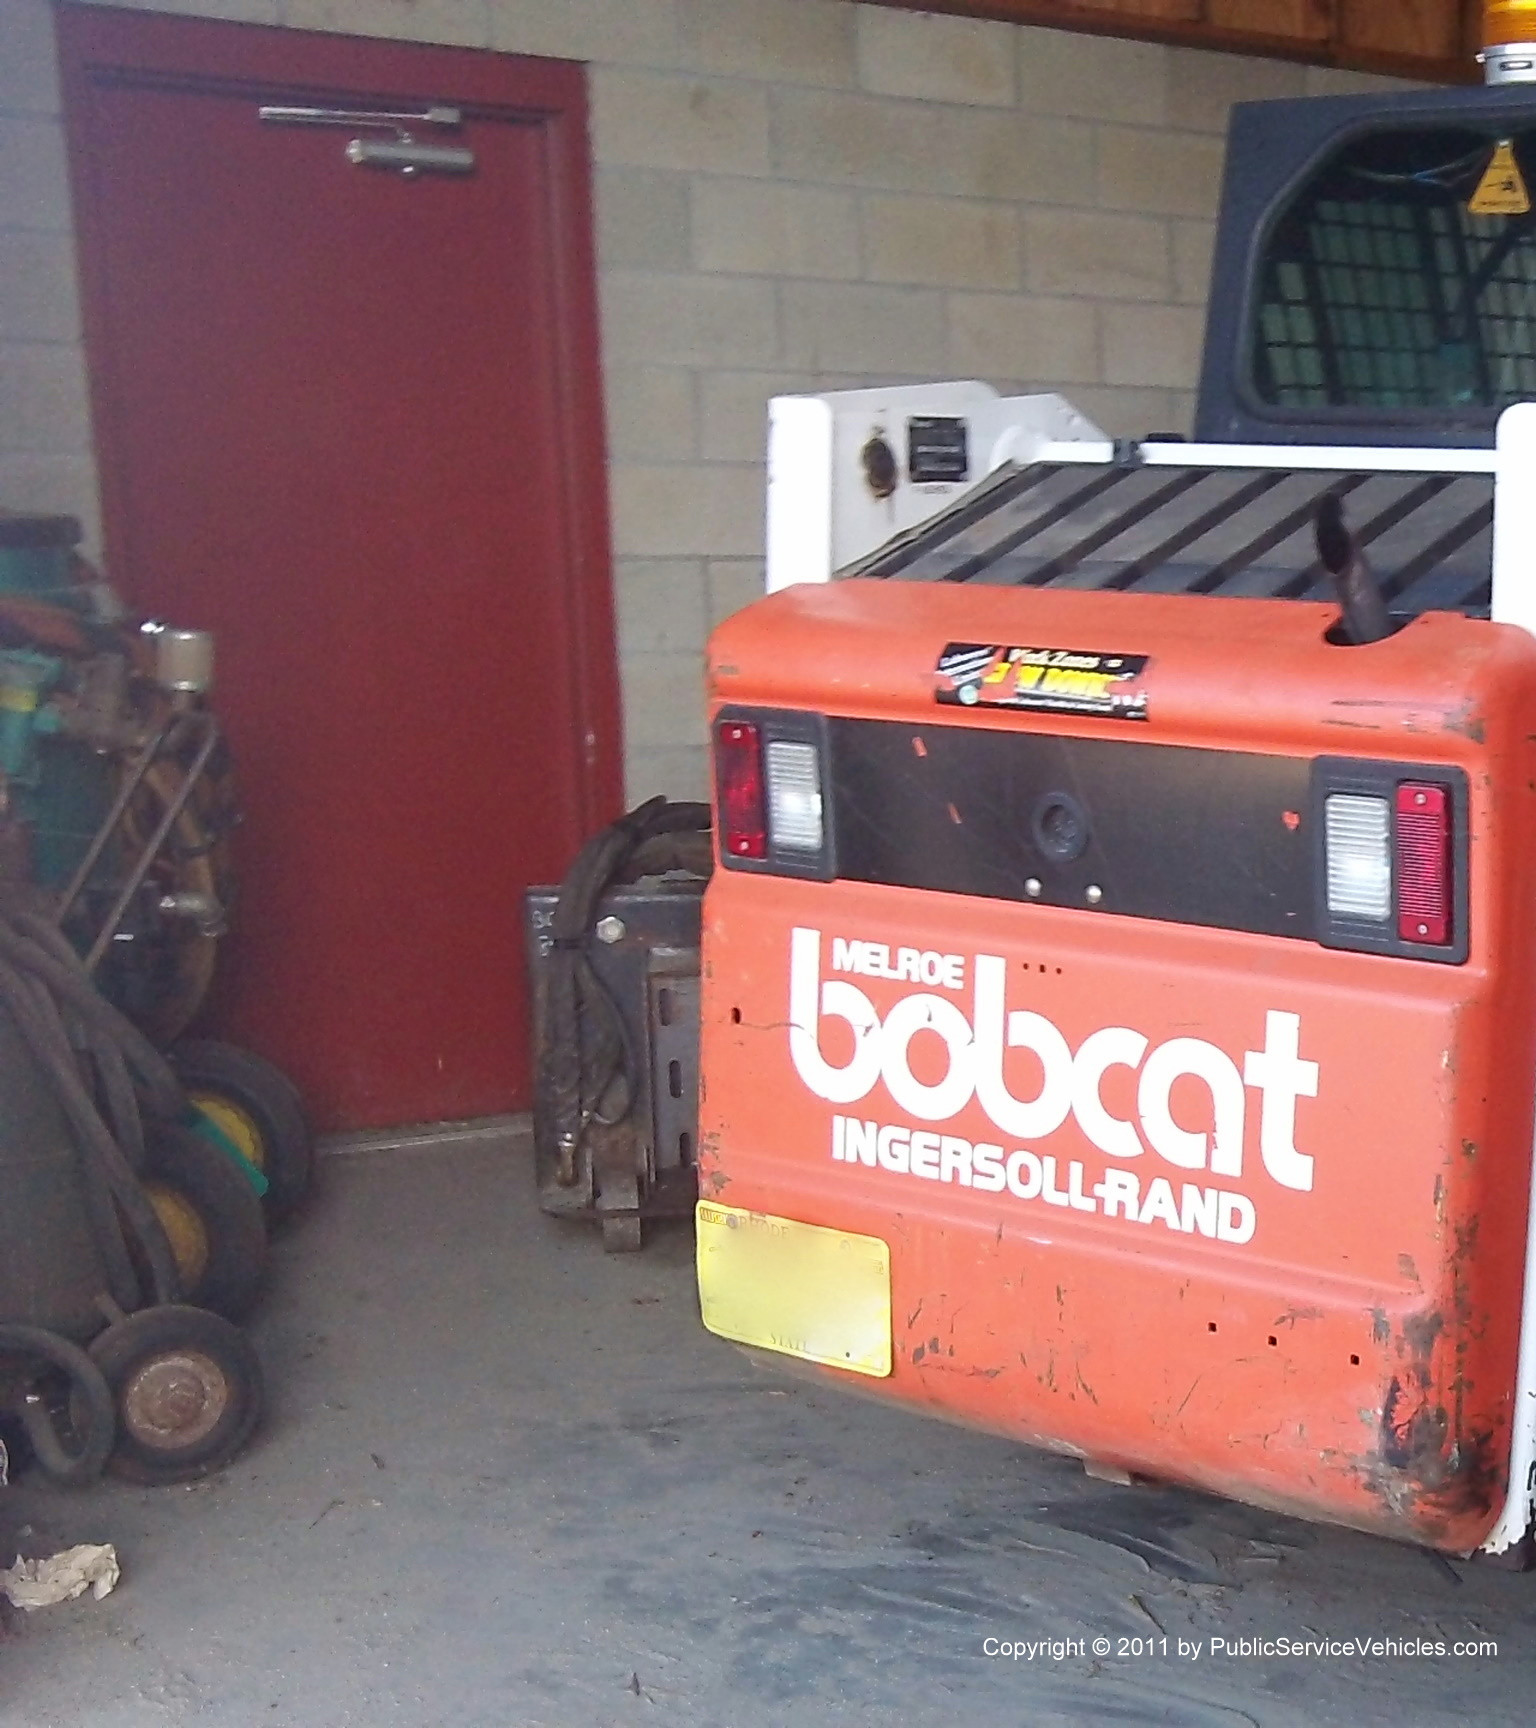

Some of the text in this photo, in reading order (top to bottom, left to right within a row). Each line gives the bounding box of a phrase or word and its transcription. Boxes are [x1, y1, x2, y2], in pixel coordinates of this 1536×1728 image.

[832, 936, 965, 990] MELROE
[789, 926, 1320, 1192] bobcat
[831, 1114, 1257, 1245] INGERSOLL-RAND
